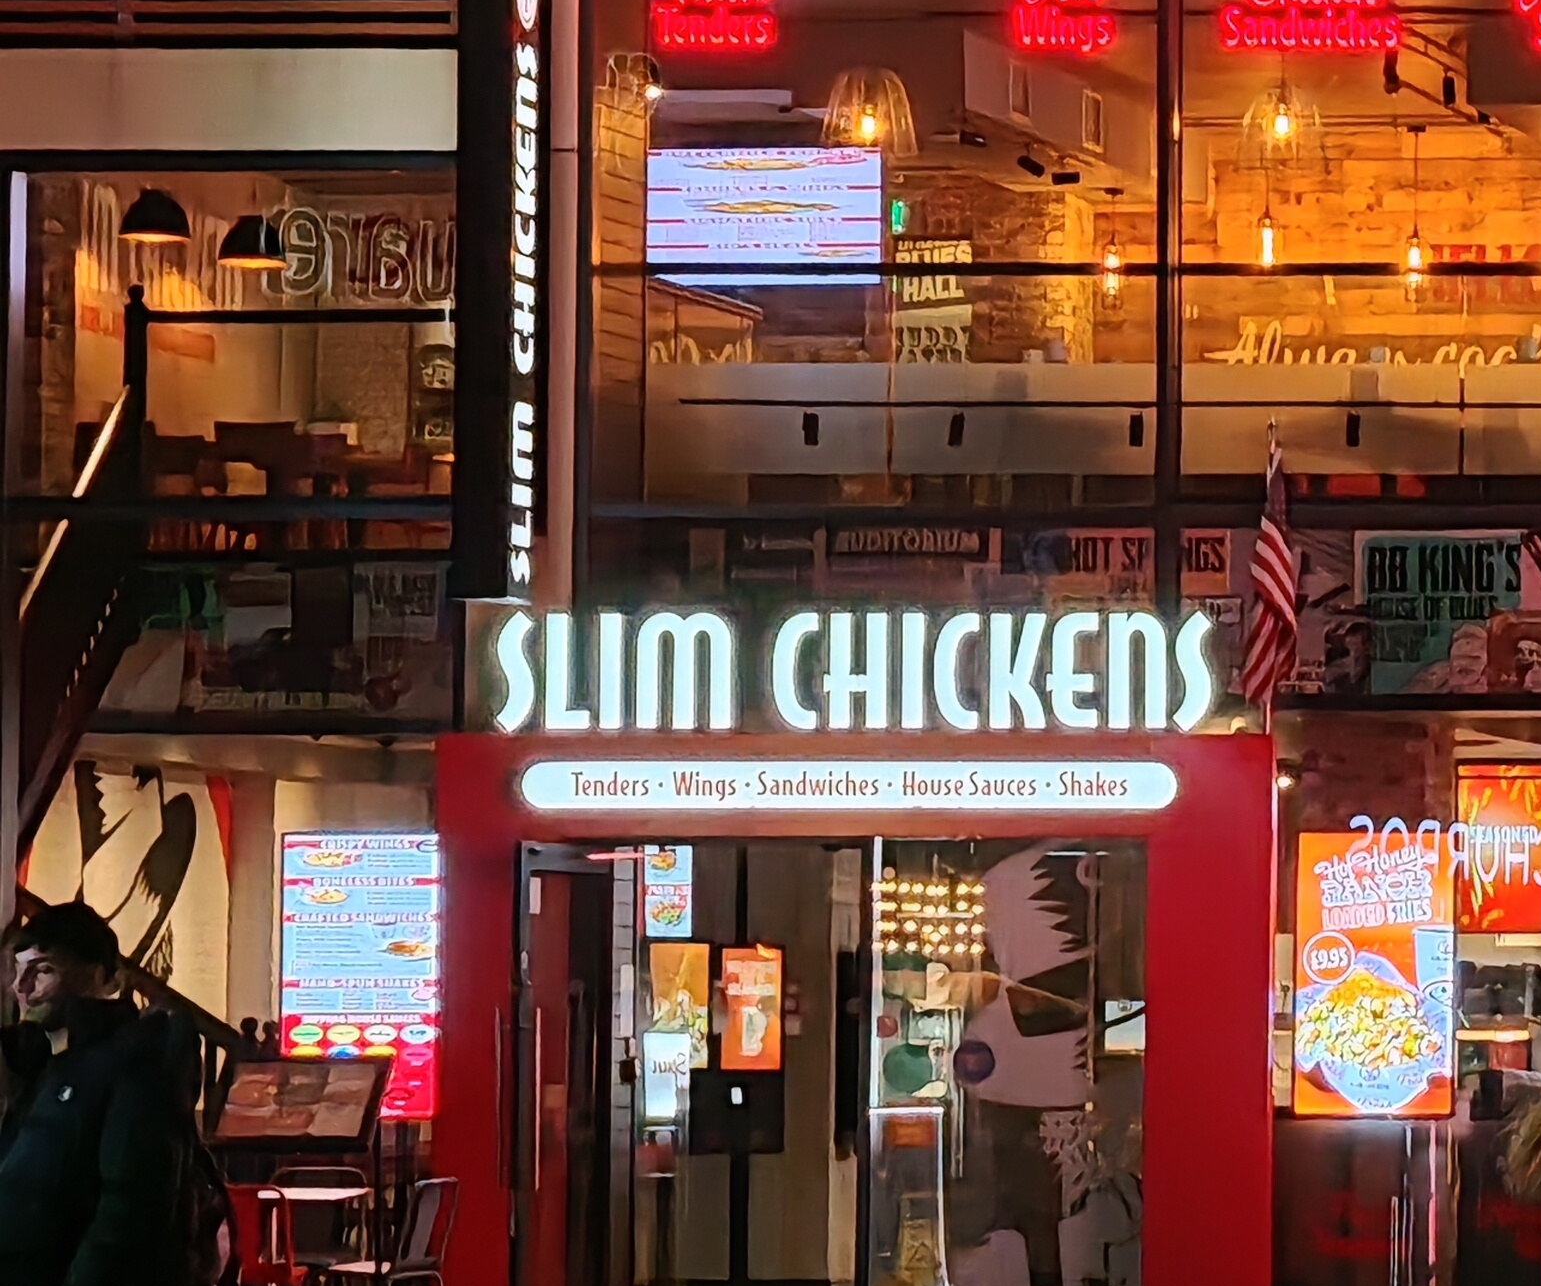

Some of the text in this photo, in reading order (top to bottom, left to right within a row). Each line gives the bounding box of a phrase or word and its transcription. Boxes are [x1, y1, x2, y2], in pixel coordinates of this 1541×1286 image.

[657, 5, 775, 47] Tenders
[1014, 10, 1113, 54] Wings
[1221, 8, 1399, 50] Sandwiches
[508, 42, 540, 585] SLIM CHICKENS
[494, 610, 1213, 733] SLIM CHICKENS
[570, 770, 1129, 802] Tenders Wings Sandwiches House Sauces Shakes
[1350, 844, 1440, 876] Honey
[1320, 870, 1433, 908] RANCH
[1321, 898, 1433, 931] LOADED FRIES
